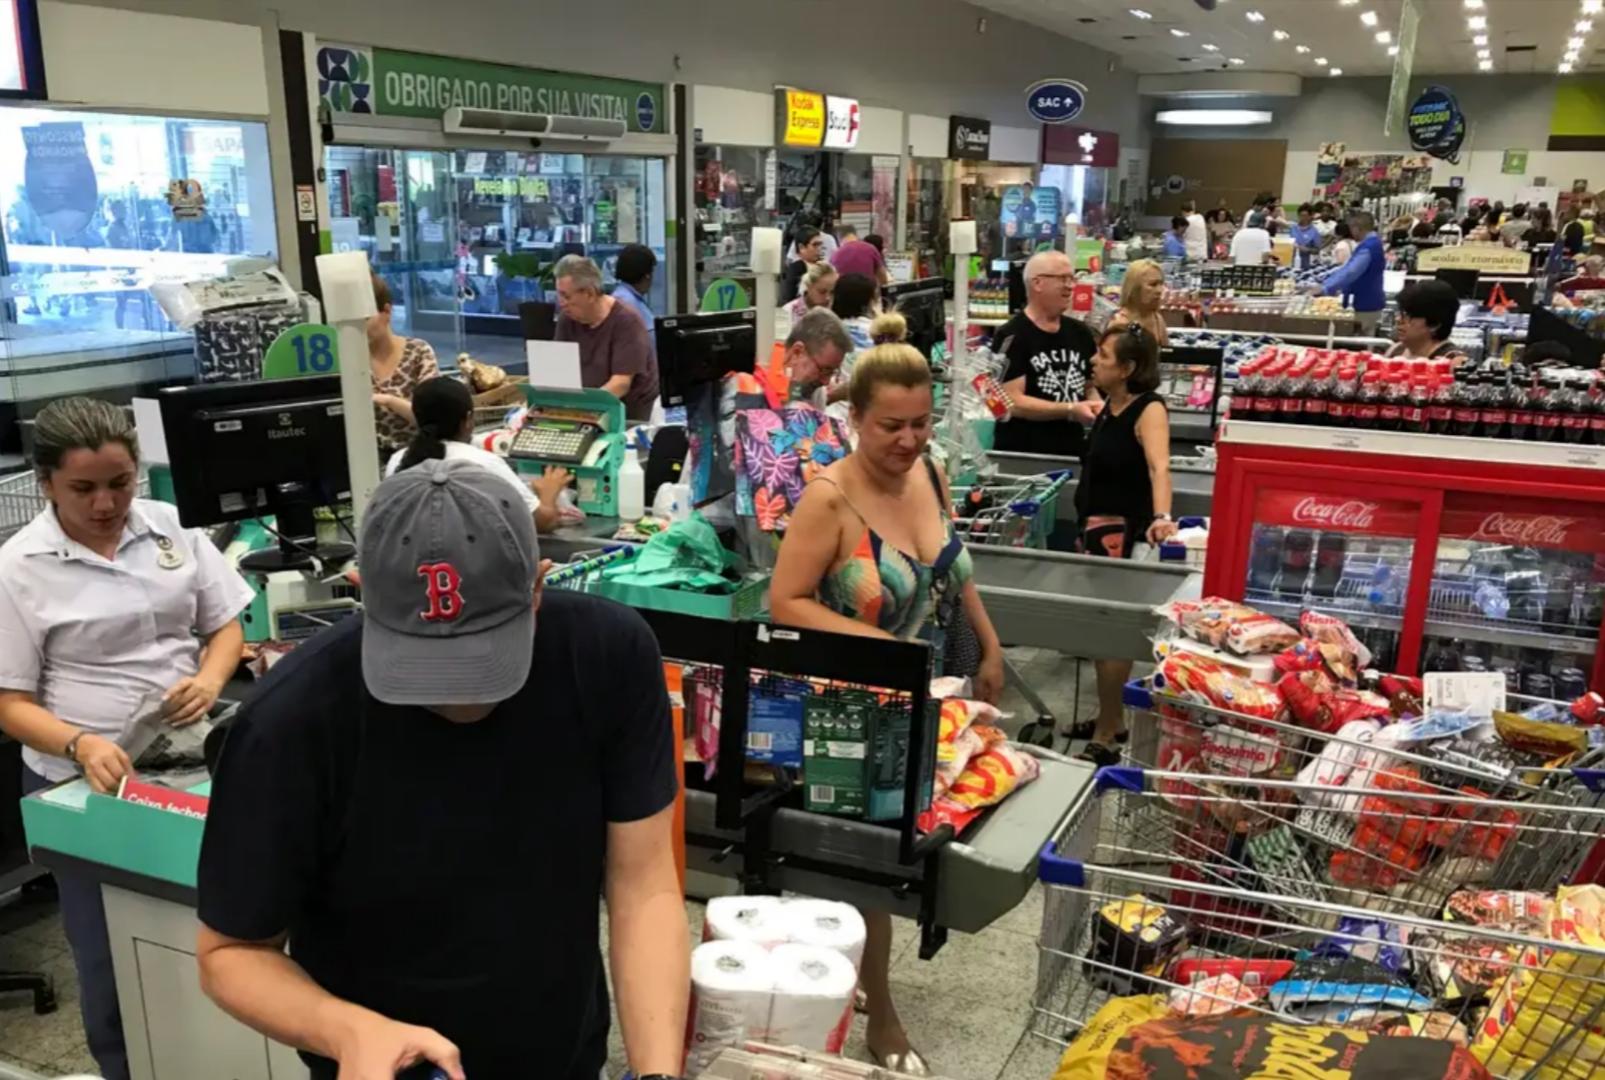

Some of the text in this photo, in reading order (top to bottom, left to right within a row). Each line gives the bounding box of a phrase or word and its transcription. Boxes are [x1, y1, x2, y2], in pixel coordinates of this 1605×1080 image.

[384, 71, 629, 121] OBRIGADO POR SUA VISITA!
[1037, 96, 1061, 108] SAC
[717, 284, 737, 310] 17
[290, 333, 334, 372] 18
[417, 562, 466, 622] B
